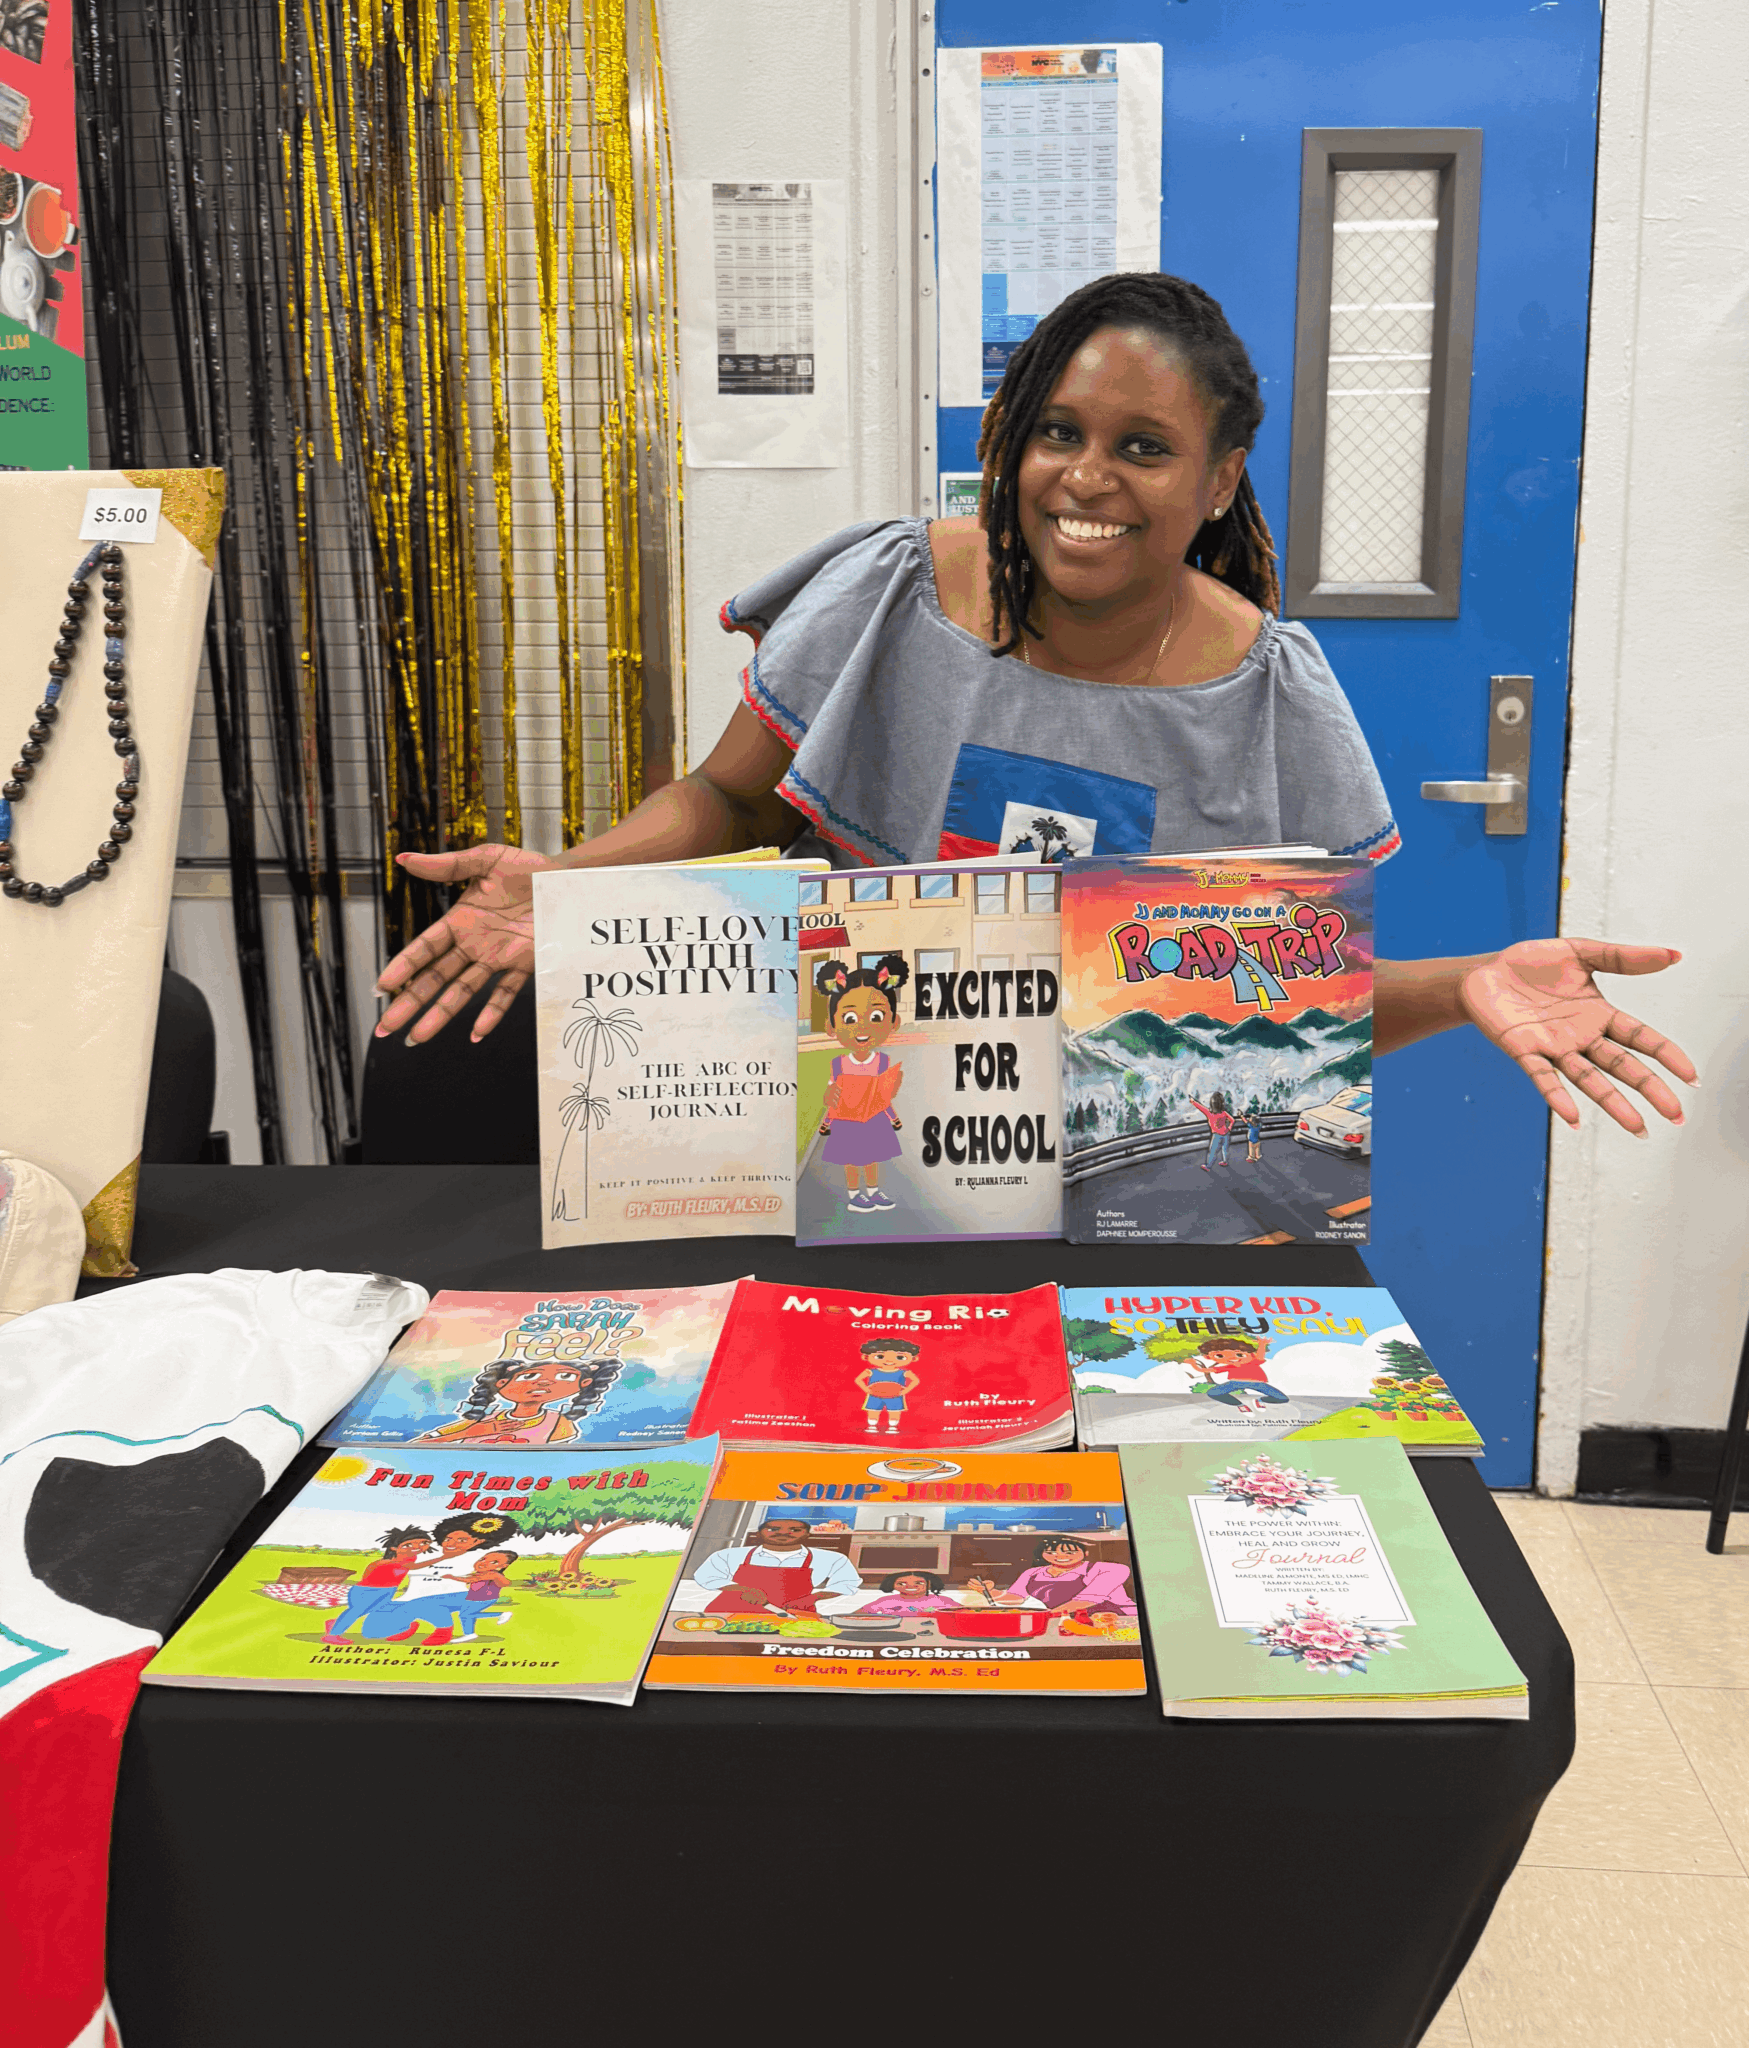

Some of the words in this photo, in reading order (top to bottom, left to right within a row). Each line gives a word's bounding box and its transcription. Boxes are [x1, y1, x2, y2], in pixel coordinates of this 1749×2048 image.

[950, 495, 976, 505] AND
[94, 507, 147, 523] $5.00
[1152, 905, 1179, 920] AND
[1275, 905, 1287, 918] A
[591, 915, 798, 945] SELF-LOVE
[643, 943, 754, 969] WITH
[1108, 921, 1239, 983] ROAD
[915, 969, 1059, 1021] EXCITED
[641, 1063, 685, 1078] THE
[695, 1061, 737, 1077] ABC
[746, 1061, 772, 1076] OF
[955, 1042, 1020, 1091] FOR
[649, 1102, 747, 1121] JOURNAL
[922, 1114, 1056, 1167] SCHOOL
[600, 1181, 626, 1189] KEEP
[647, 1177, 694, 1186] POSITIVE
[710, 1175, 736, 1183] KEEP
[955, 1177, 966, 1187] BY:
[999, 1175, 1023, 1185] FLEURY
[627, 1202, 648, 1218] BY:
[651, 1199, 683, 1216] RUTH
[685, 1198, 731, 1215] FLEURY,
[764, 1196, 782, 1212] ED
[1096, 1209, 1125, 1218] Authors
[1096, 1220, 1106, 1228] RJ
[1107, 1220, 1138, 1228] LAMARRE
[1328, 1220, 1367, 1229] Illustrator
[1096, 1230, 1127, 1238] DAPHNEE
[1315, 1231, 1342, 1239] RODNEY
[1343, 1231, 1366, 1239] SANON
[537, 1300, 583, 1313] How
[590, 1298, 641, 1311] Does
[1104, 1296, 1250, 1314] HYPER
[519, 1311, 635, 1332] SARAH
[851, 1321, 919, 1331] Coloring
[923, 1323, 963, 1331] Book
[1109, 1317, 1166, 1335] SO
[1165, 1317, 1270, 1335] THEY
[1273, 1317, 1370, 1338] SAY!
[498, 1326, 643, 1360] Feel?
[979, 1392, 1000, 1400] by
[365, 1467, 434, 1489] Fun
[448, 1470, 552, 1491] Times
[567, 1469, 650, 1491] with
[776, 1482, 888, 1500] SOUP
[892, 1482, 1072, 1501] JOUMOU
[446, 1491, 529, 1511] Mom
[1231, 1547, 1367, 1569] Journal
[319, 1645, 391, 1655] Author:
[408, 1647, 471, 1656] Runesa
[479, 1648, 506, 1656] F-L
[761, 1643, 874, 1658] Freedom
[879, 1646, 1031, 1659] Celebration
[309, 1655, 417, 1666] Illustrator:
[423, 1658, 481, 1667] Justin
[488, 1658, 559, 1668] Saviour
[774, 1664, 798, 1675] By
[806, 1664, 848, 1675] Ruth
[976, 1667, 1000, 1677] Ed
